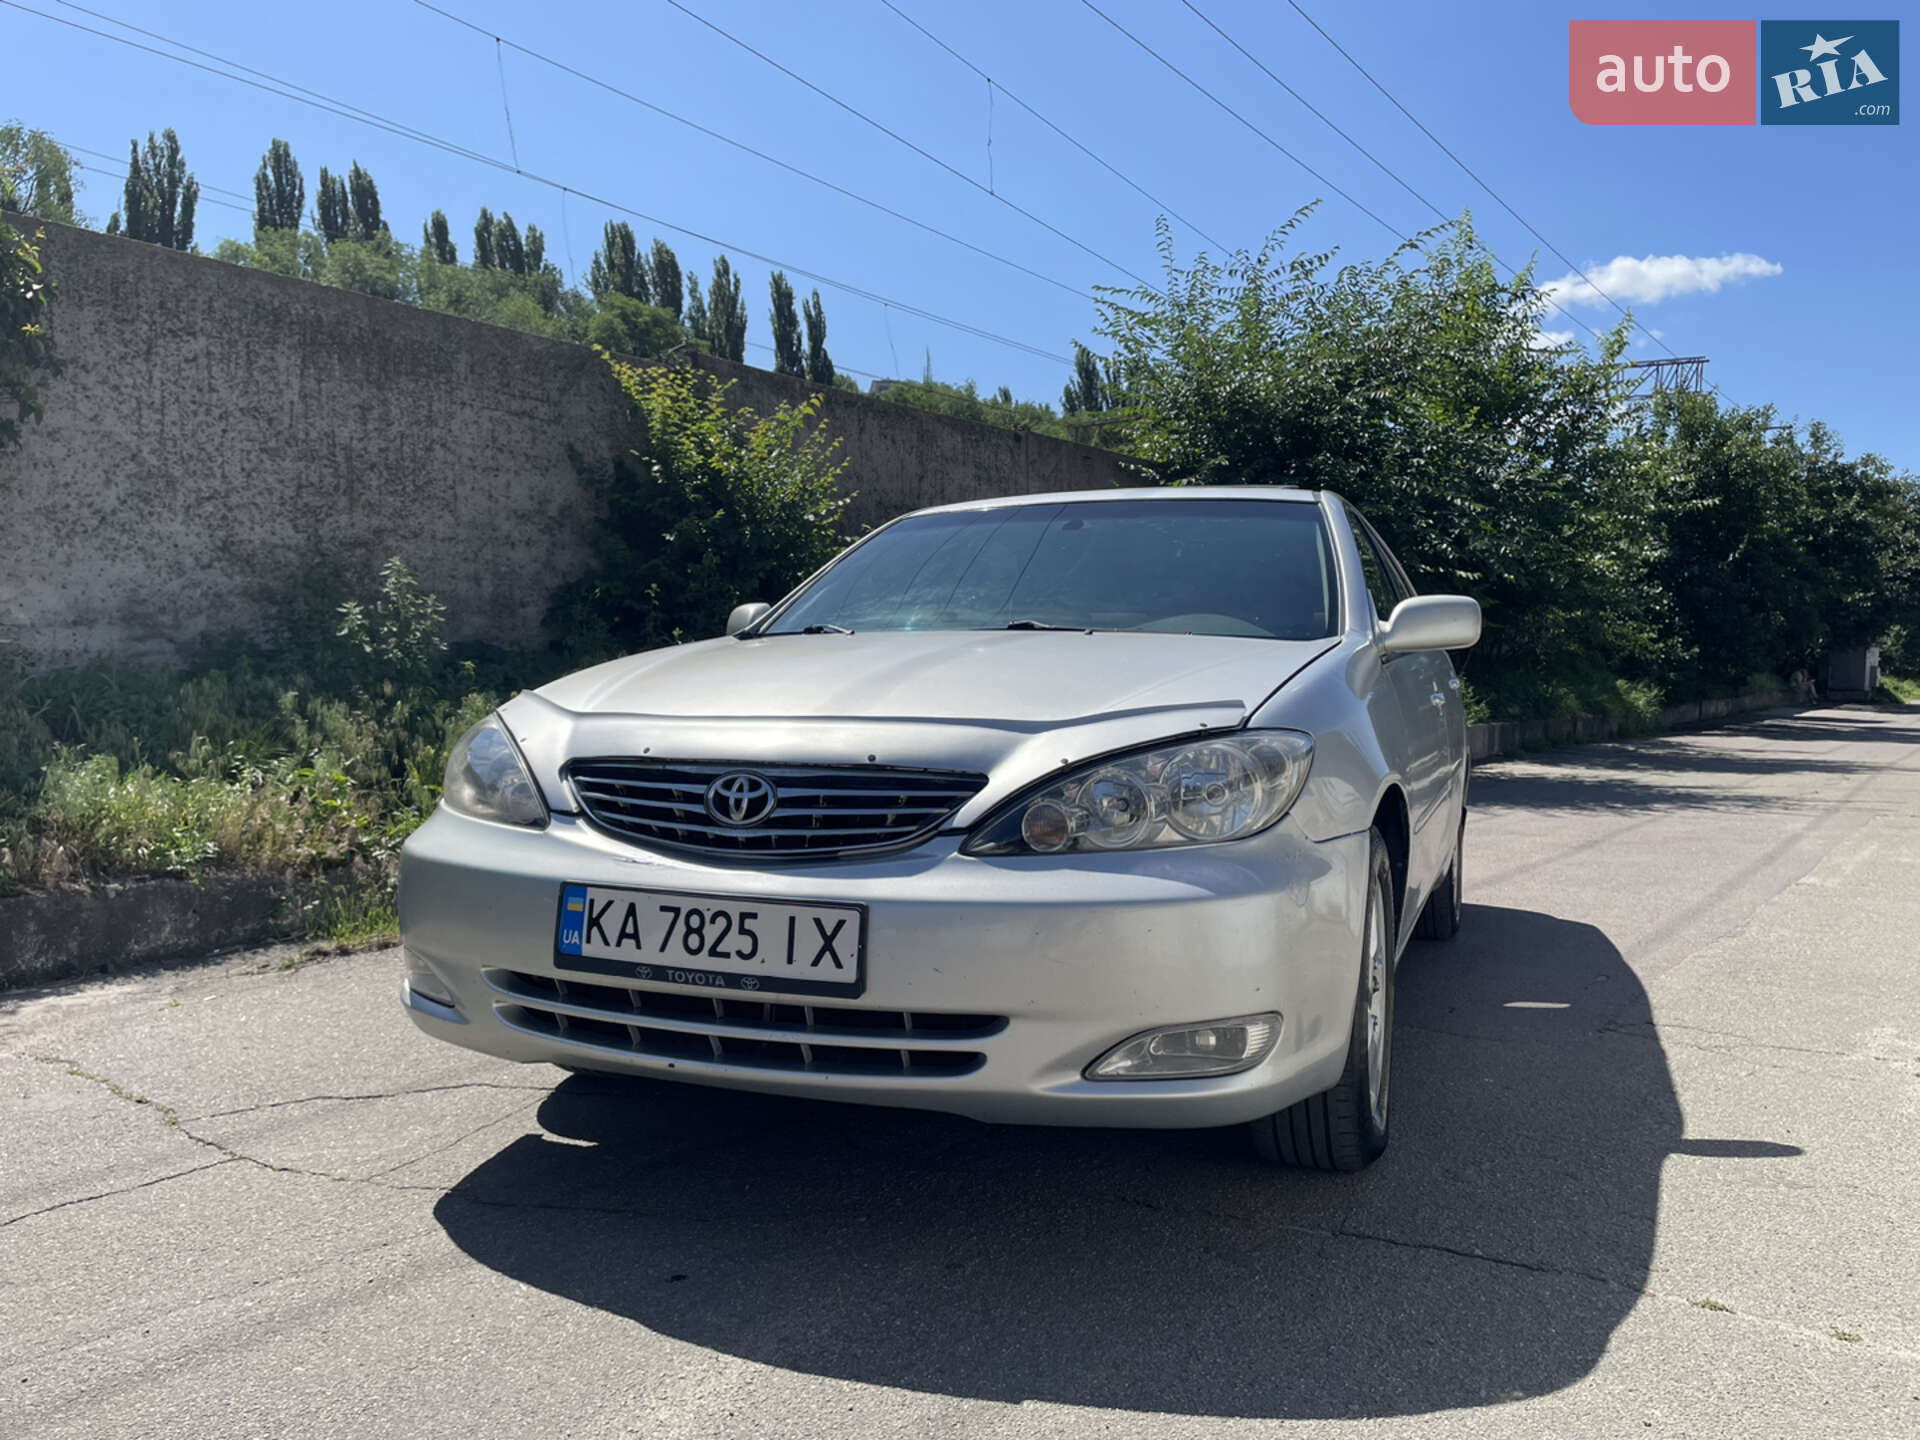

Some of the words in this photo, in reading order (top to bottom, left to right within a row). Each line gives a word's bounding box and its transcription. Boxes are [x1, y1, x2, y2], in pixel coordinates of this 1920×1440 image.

[563, 929, 581, 945] UA
[585, 898, 642, 950] KA
[659, 905, 759, 961] 7825
[786, 915, 848, 969] IX
[666, 969, 726, 987] TOYOTA
